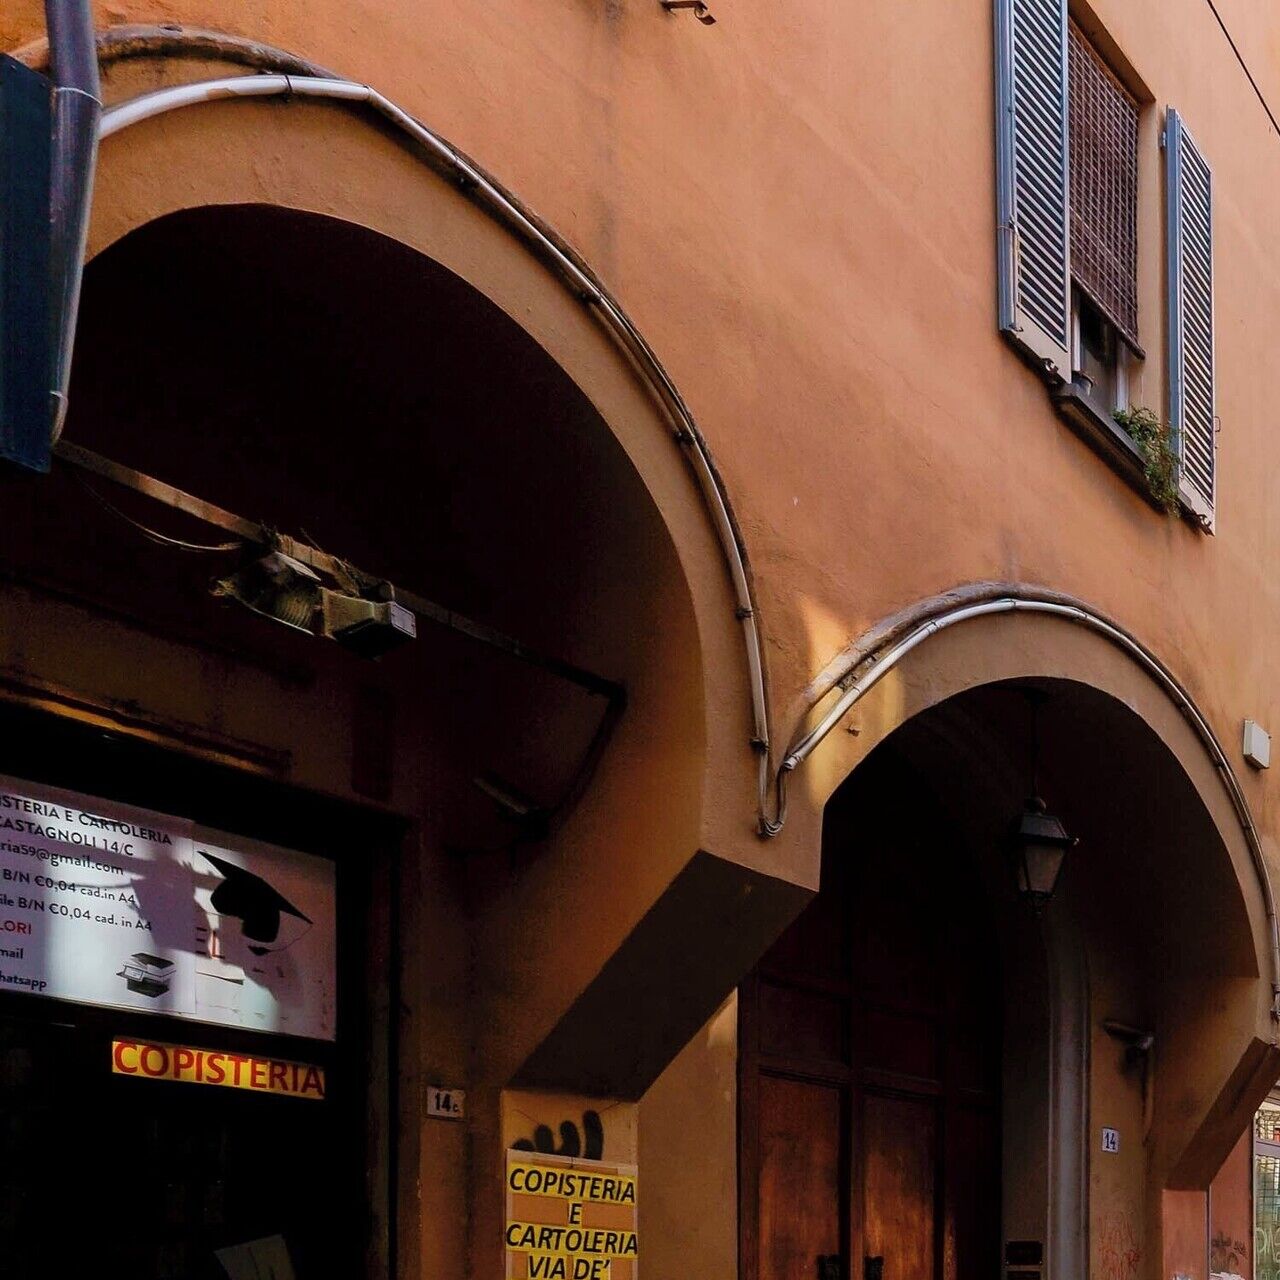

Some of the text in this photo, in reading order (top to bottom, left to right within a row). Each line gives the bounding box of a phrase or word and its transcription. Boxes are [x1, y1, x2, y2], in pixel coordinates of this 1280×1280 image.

[66, 810, 73, 822] E
[79, 813, 172, 845] CARTOLERIA
[103, 838, 134, 856] 14/C
[3, 868, 30, 883] B/N
[35, 875, 76, 893] €0,04
[119, 894, 136, 904] A4
[18, 898, 45, 912] B/N
[49, 903, 91, 919] €0,04
[95, 913, 118, 926] cad.
[122, 916, 132, 928] in
[135, 921, 152, 931] A4
[114, 1042, 324, 1097] COPISTERIA
[1104, 1132, 1116, 1150] 14
[509, 1168, 635, 1203] COPISTERIA
[569, 1203, 582, 1225] E
[506, 1224, 637, 1254] CARTOLERIA
[529, 1256, 566, 1280] VIA
